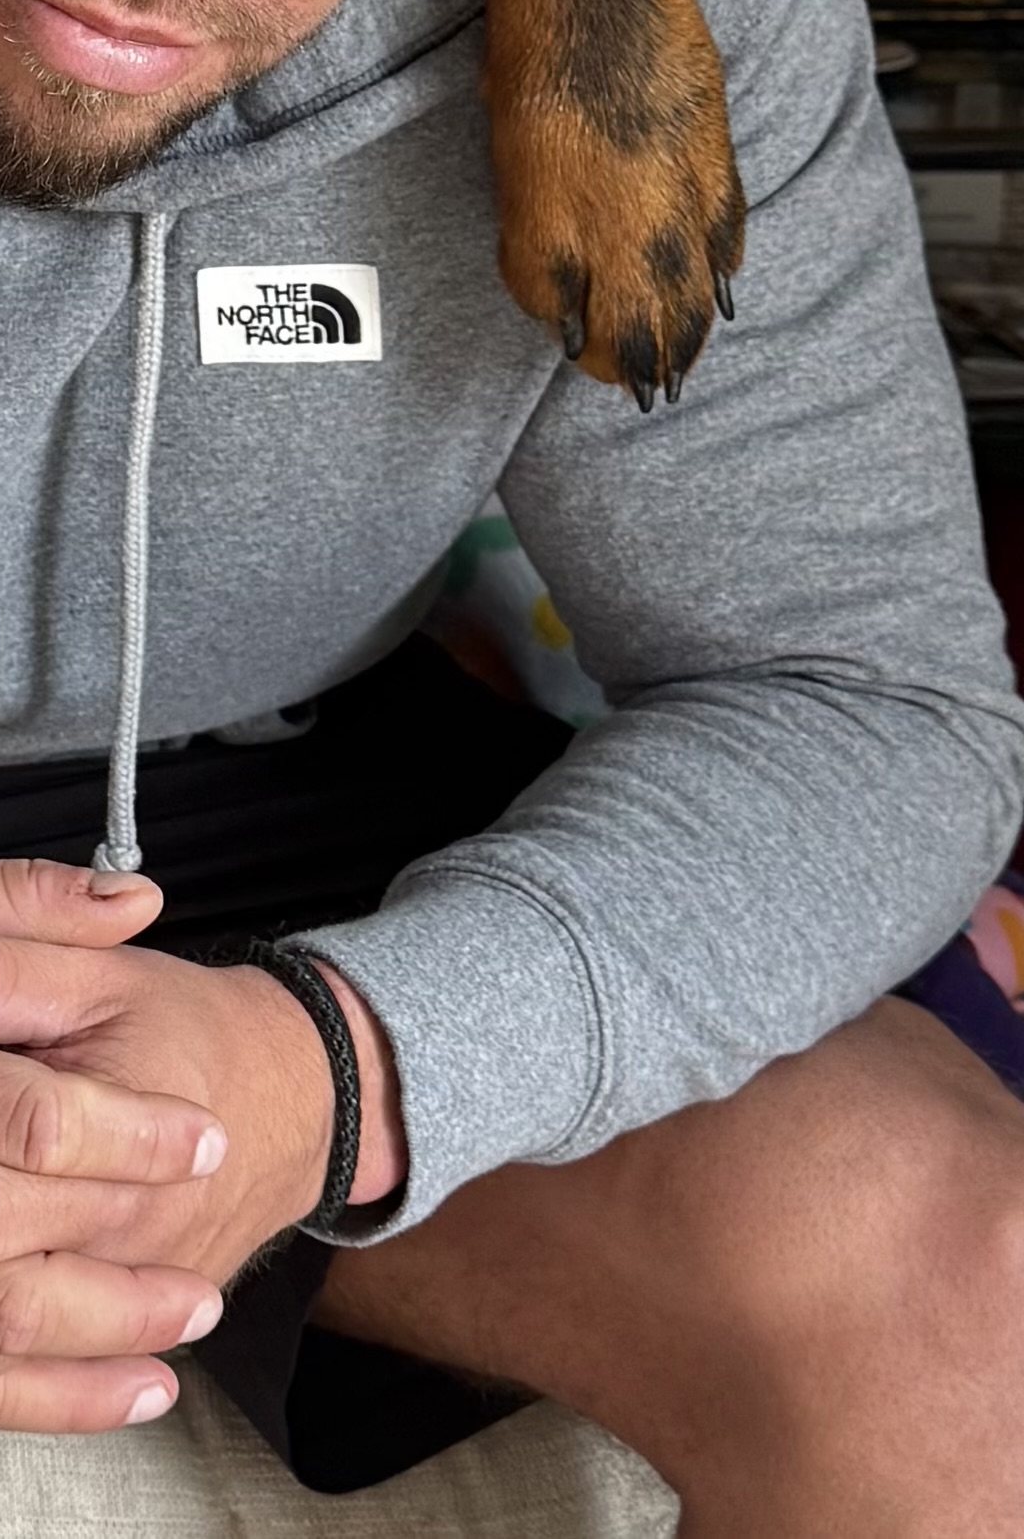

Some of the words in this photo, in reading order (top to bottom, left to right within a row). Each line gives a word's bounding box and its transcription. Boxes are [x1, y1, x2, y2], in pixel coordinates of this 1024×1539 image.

[256, 283, 307, 303] THE
[217, 304, 310, 326] NORTH
[246, 324, 311, 345] FACE
